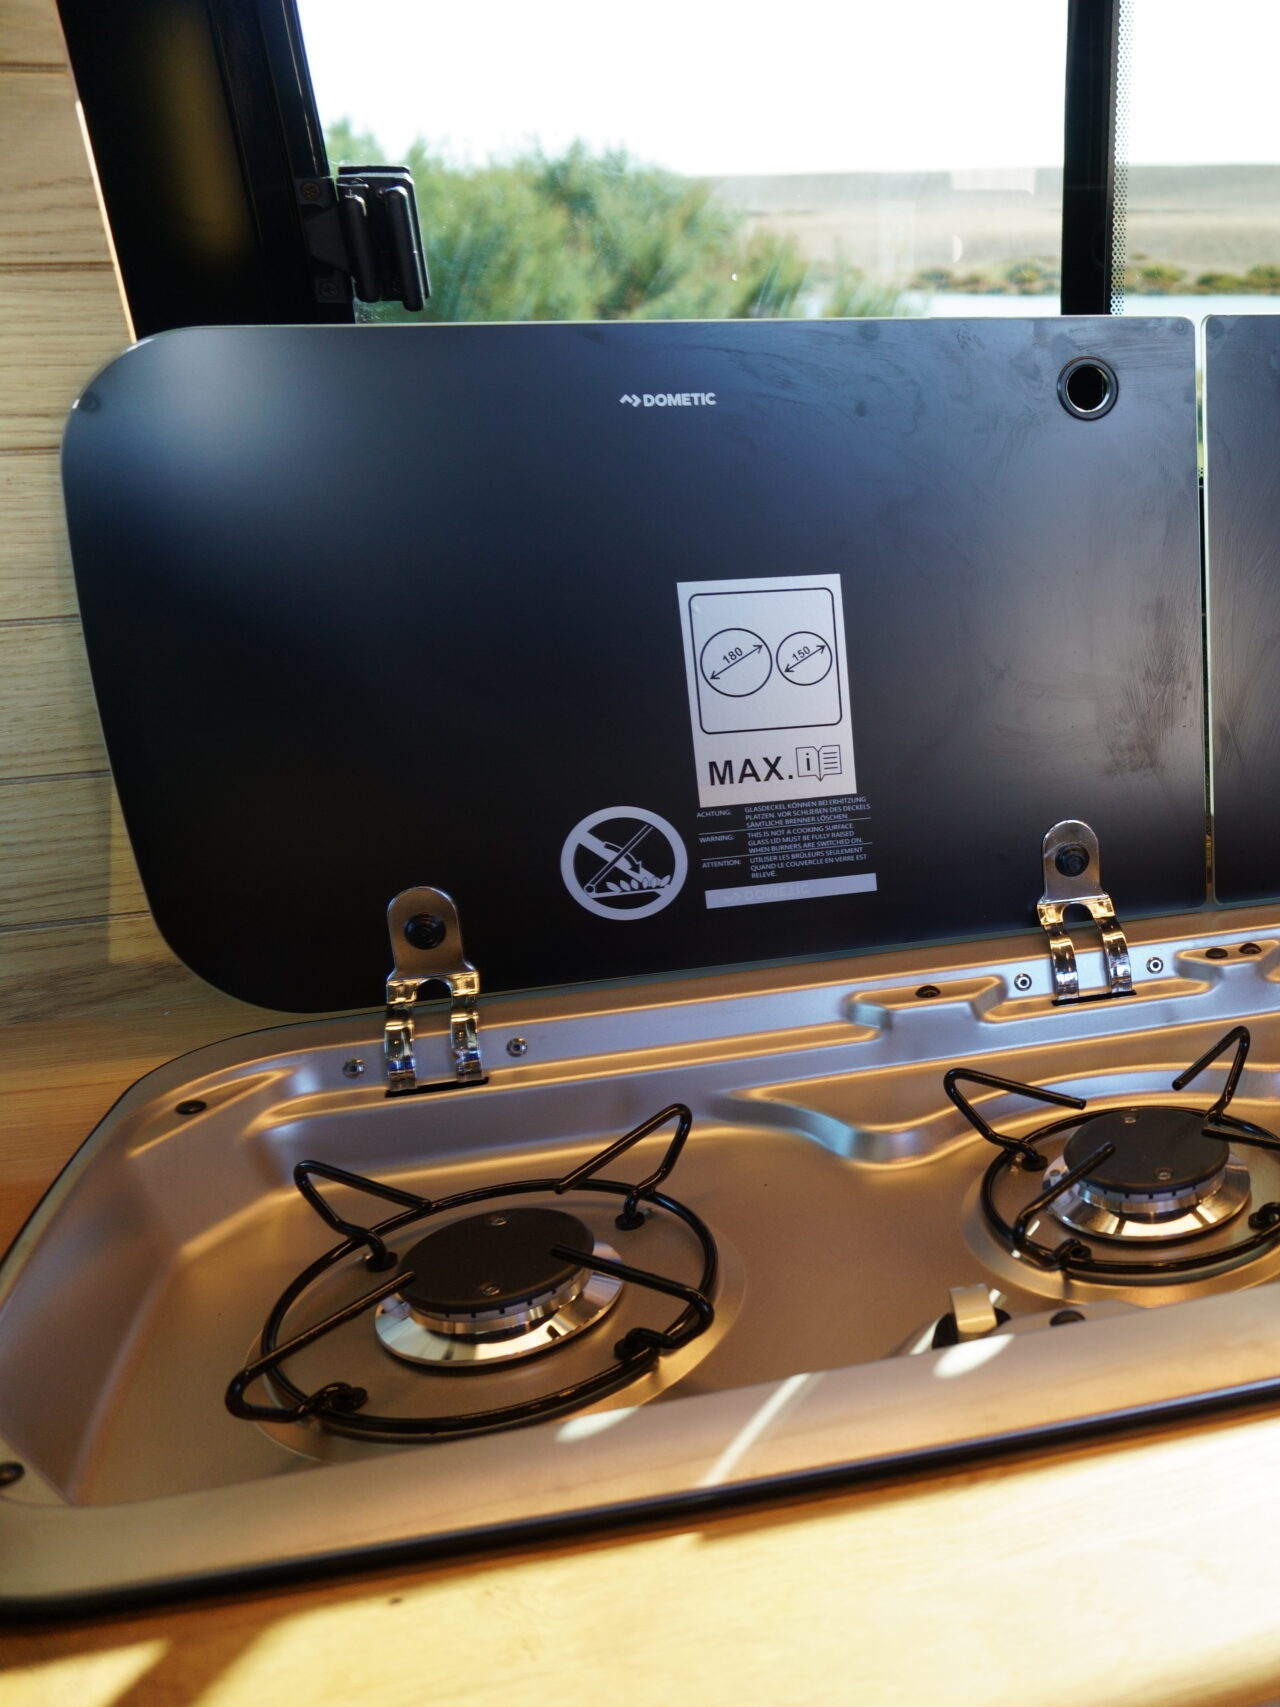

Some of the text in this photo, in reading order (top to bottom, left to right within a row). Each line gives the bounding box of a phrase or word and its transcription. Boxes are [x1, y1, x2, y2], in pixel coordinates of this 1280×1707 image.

[642, 392, 717, 407] DOMETIC
[722, 646, 744, 665] 180
[791, 645, 811, 662] 150
[708, 755, 794, 786] MAX.
[777, 810, 792, 818] VOR
[843, 803, 871, 812] DECKELS
[747, 831, 762, 839] THIS
[792, 825, 824, 834] COOKING
[747, 838, 769, 846] GLASS
[782, 835, 801, 843] MUST
[811, 832, 830, 840] FULLY
[831, 830, 855, 838] RAISED
[748, 846, 770, 854] WHEN
[771, 843, 802, 852] BURNERS
[816, 839, 850, 847] SWITCHED
[750, 855, 778, 863] UTILISER
[779, 853, 791, 861] LES
[825, 846, 863, 856] SEULEMENT
[750, 863, 776, 872] QUAND
[785, 858, 824, 867] COUVERCLE
[835, 854, 855, 862] VERRE
